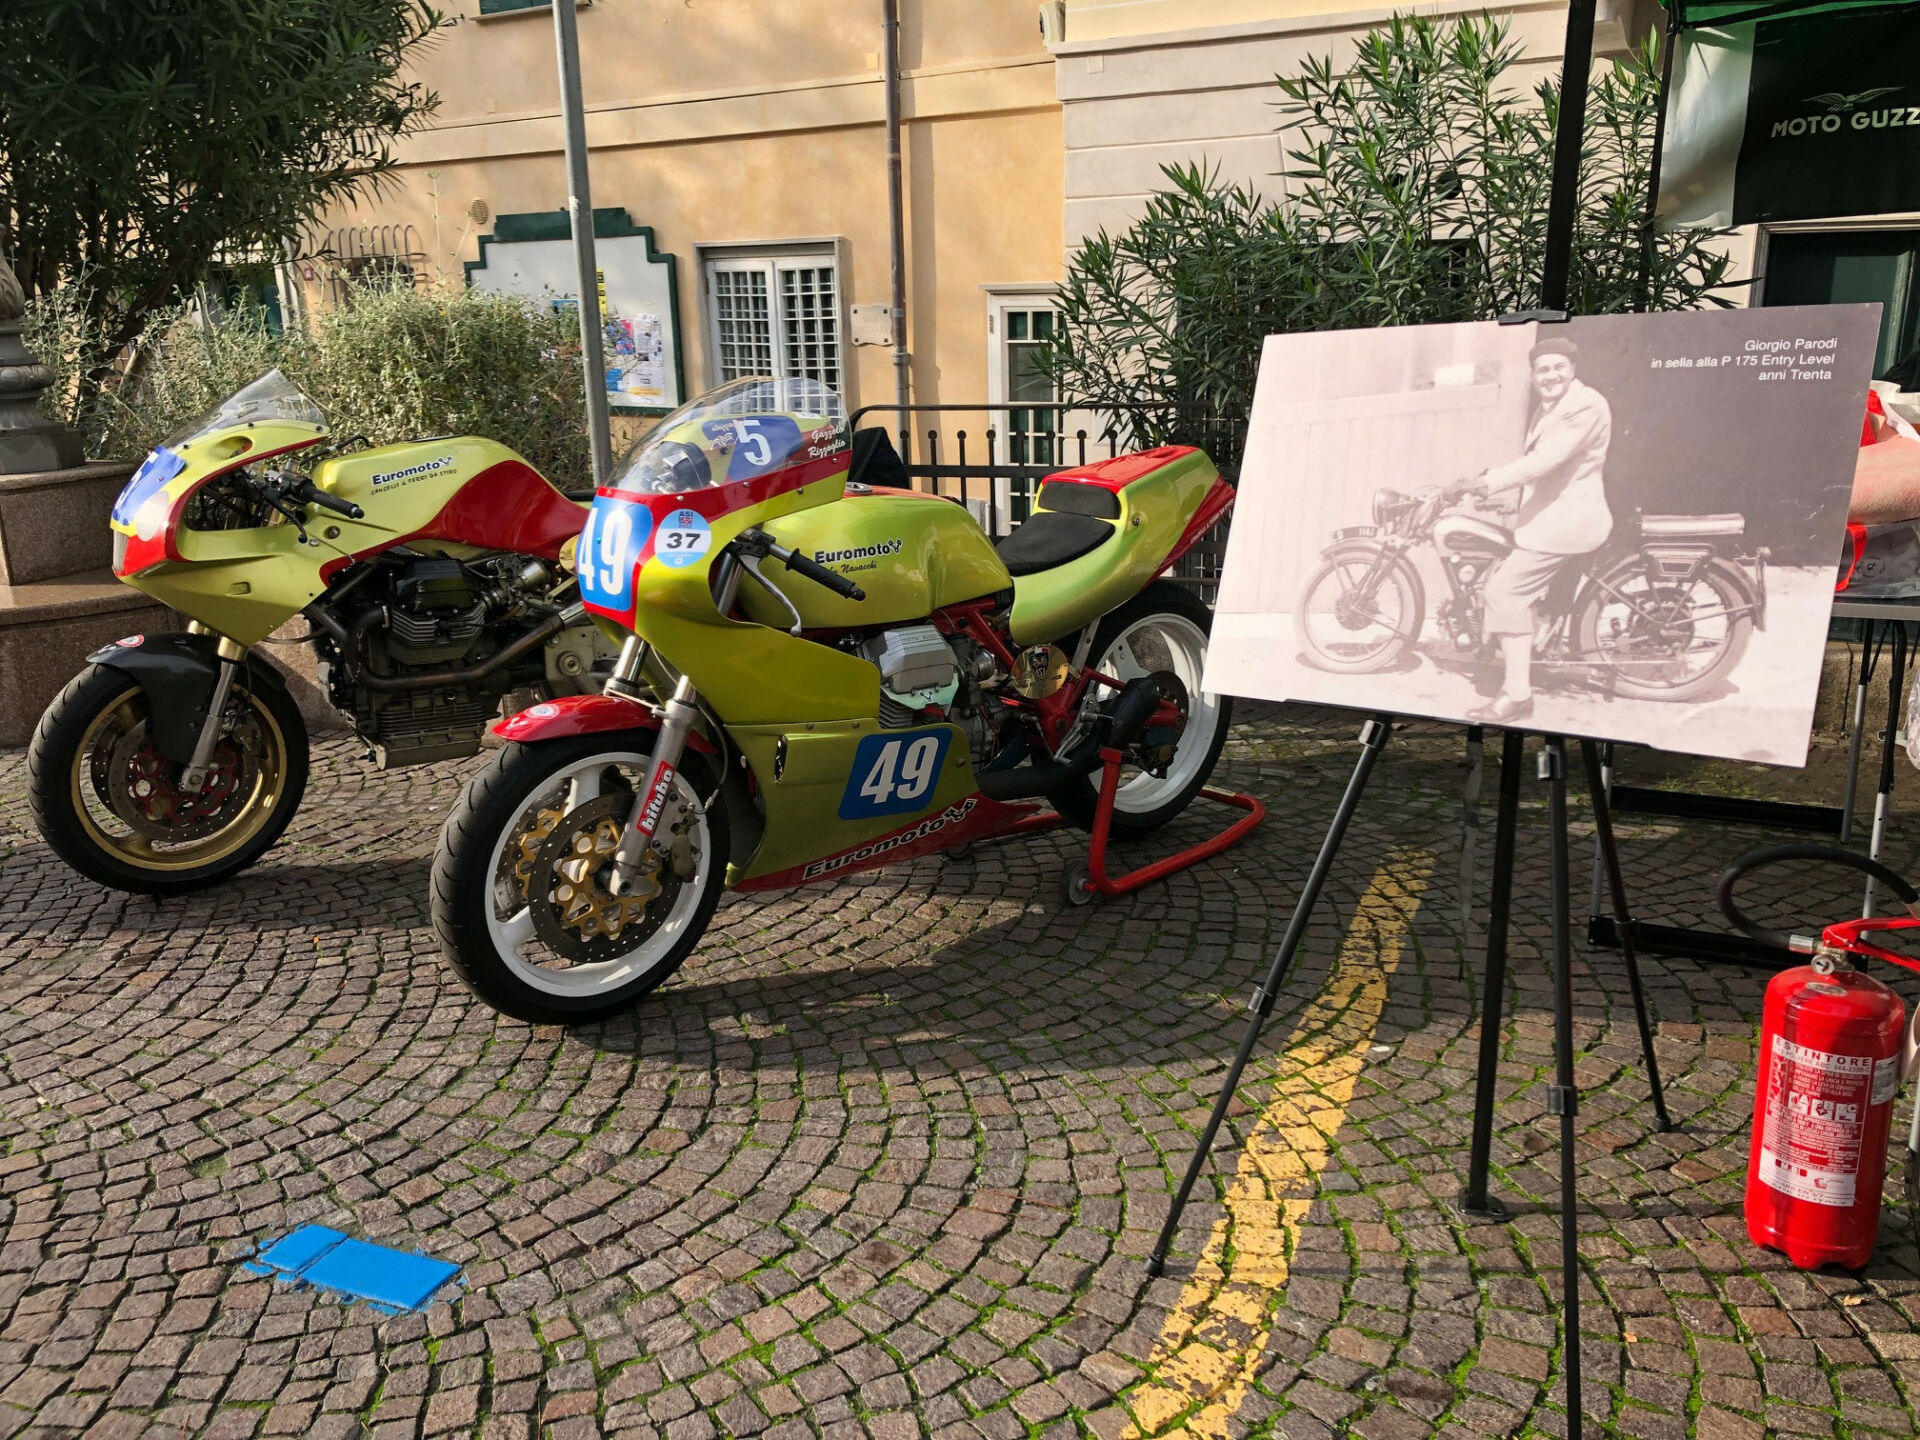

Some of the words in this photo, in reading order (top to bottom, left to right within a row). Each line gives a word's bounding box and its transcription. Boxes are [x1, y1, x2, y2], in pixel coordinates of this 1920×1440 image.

[1771, 114, 1841, 138] MOTO
[1745, 340, 1791, 353] Giorgio
[1795, 338, 1838, 351] Parodi
[1651, 358, 1662, 369] in
[1665, 357, 1693, 368] sella
[1696, 357, 1718, 367] alla
[1721, 356, 1731, 366] P
[1736, 355, 1758, 366] 175
[1762, 354, 1795, 368] Entry
[1799, 353, 1835, 365] Level
[1758, 369, 1787, 381] anni
[1790, 369, 1832, 380] Trenta
[736, 419, 772, 466] 5
[371, 461, 441, 486] Euromoto
[579, 507, 633, 595] 49
[666, 532, 701, 549] 37
[814, 543, 891, 564] Euromoto
[860, 736, 939, 804] 49
[641, 769, 673, 831] bitubo
[802, 816, 946, 880] Euromoto
[1776, 1037, 1870, 1067] ESTINTORE
